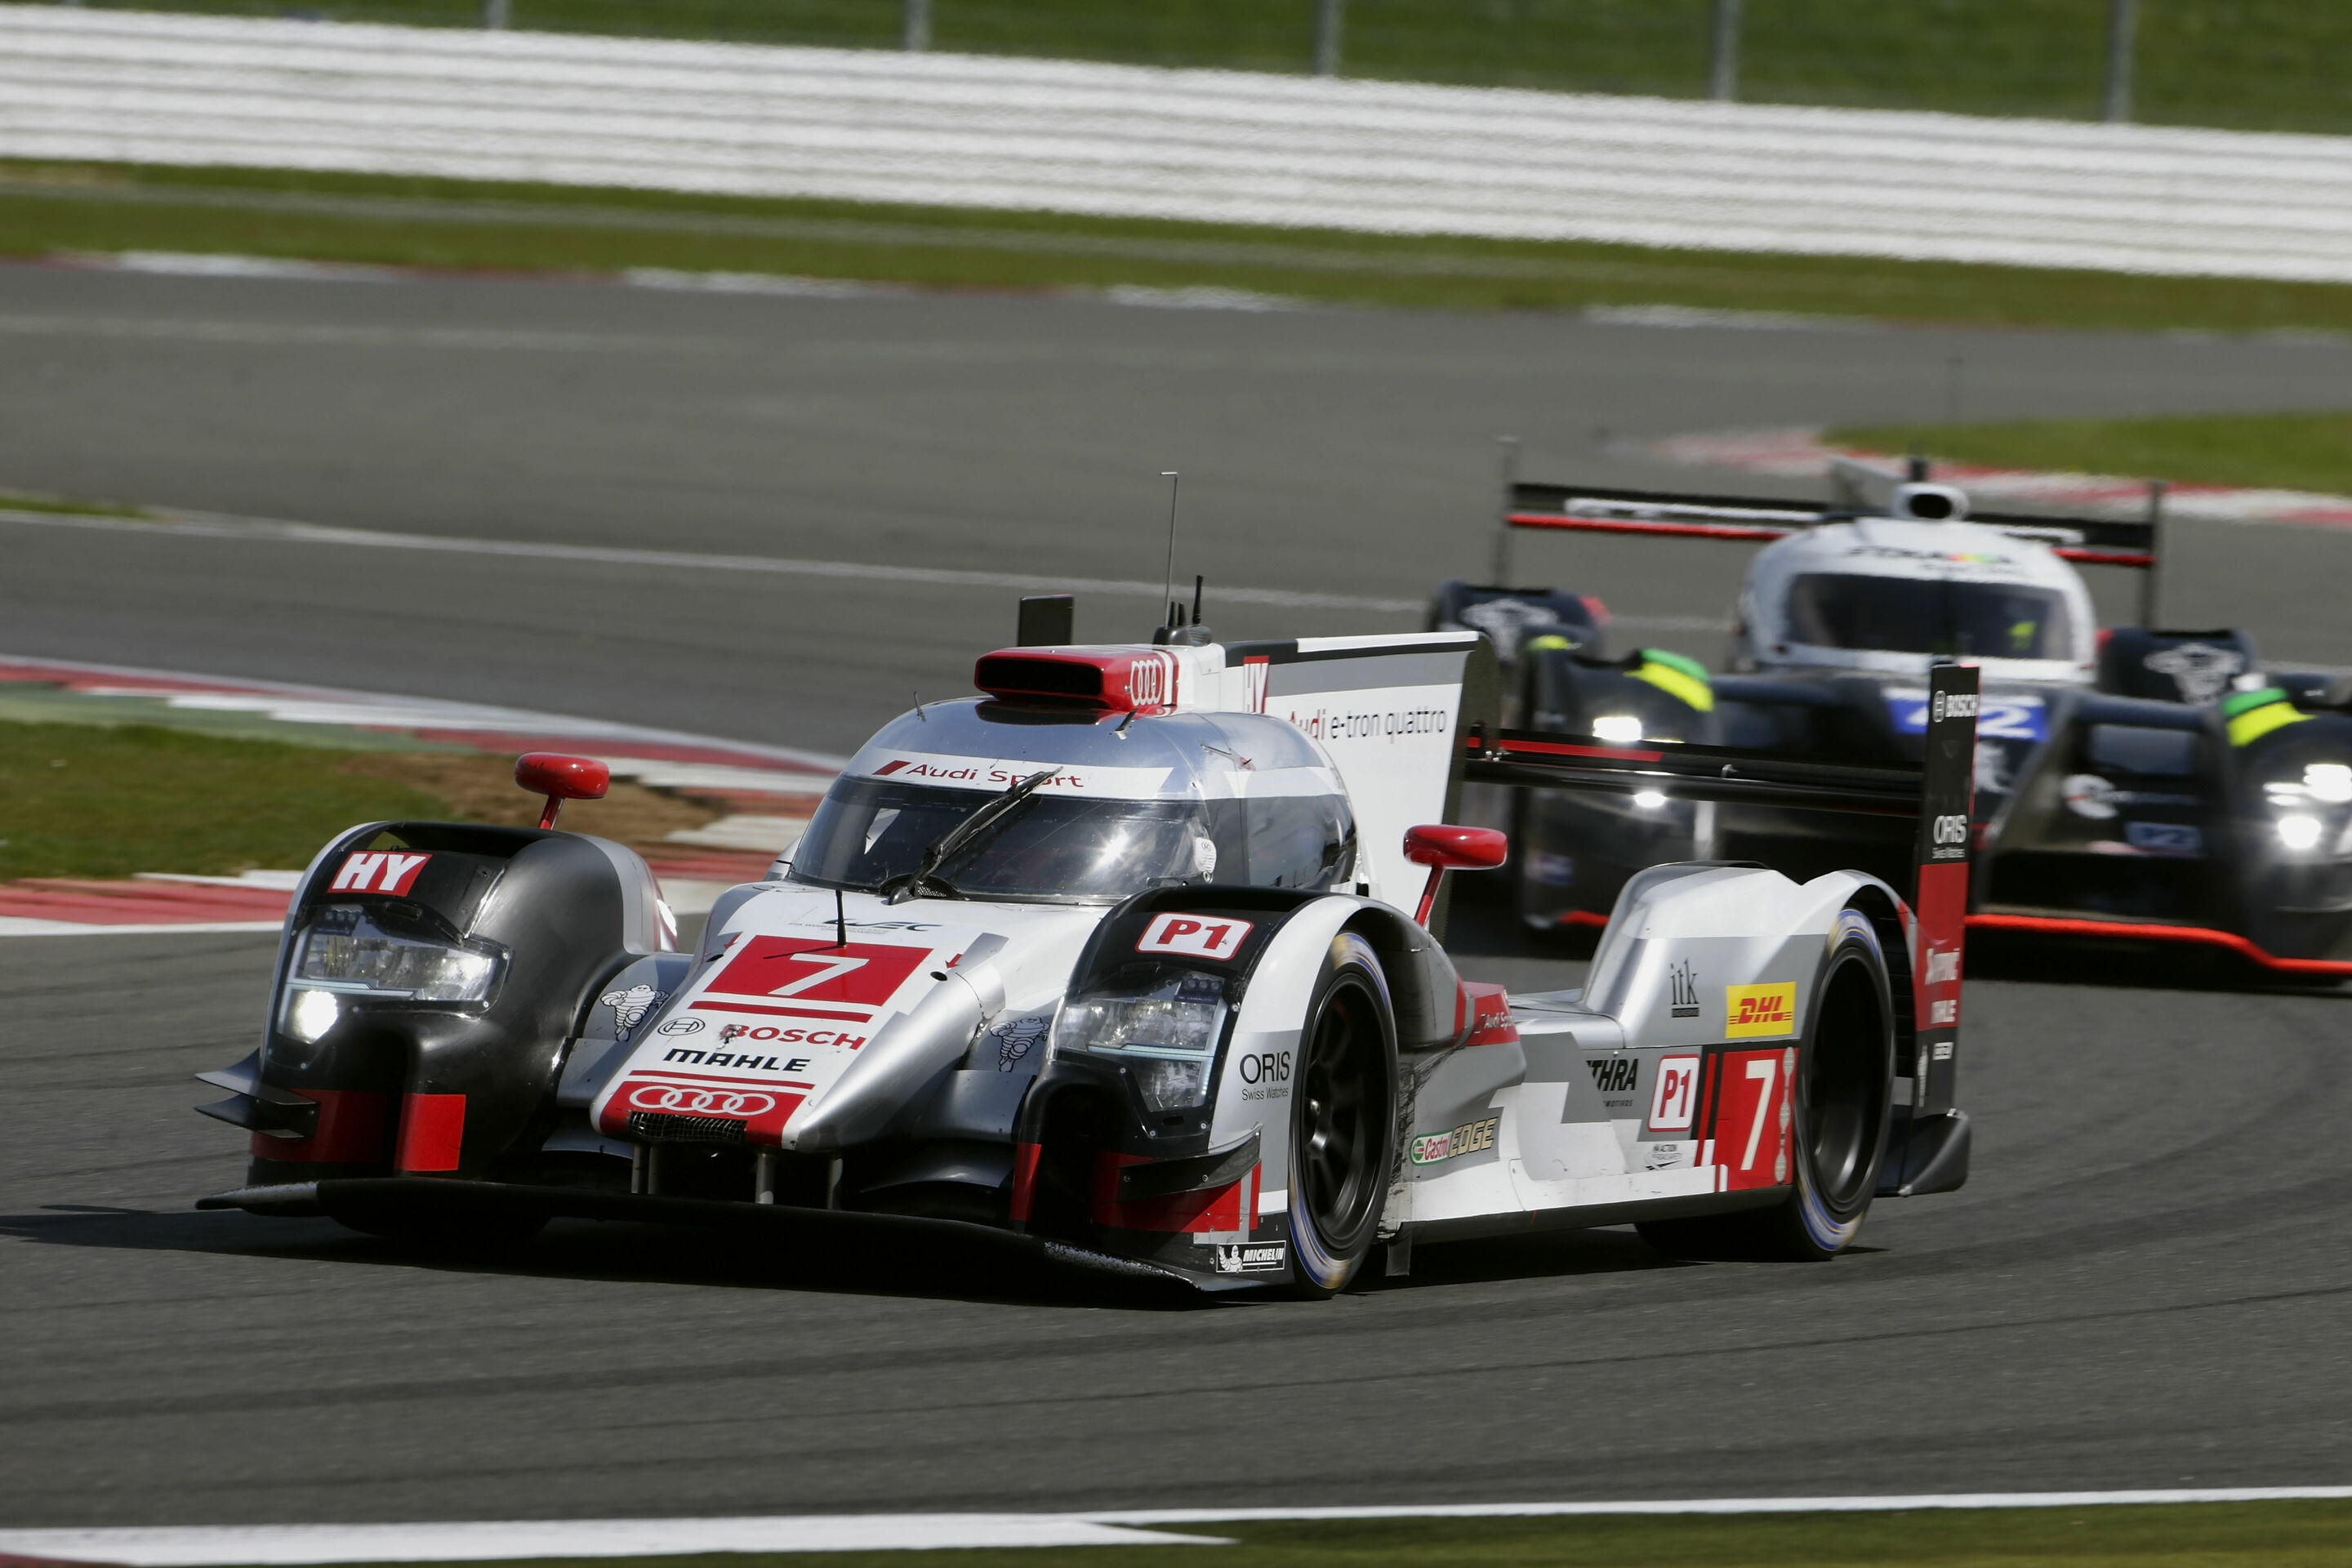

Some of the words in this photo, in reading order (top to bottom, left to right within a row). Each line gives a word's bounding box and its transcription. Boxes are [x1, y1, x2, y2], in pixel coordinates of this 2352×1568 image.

[1242, 662, 1269, 714] HY
[1330, 711, 1380, 739] e-tron
[1385, 706, 1447, 744] quattro
[906, 764, 979, 780] Audi
[332, 853, 426, 891] HY
[1156, 919, 1232, 951] P1
[767, 952, 870, 996] 7
[1670, 956, 1699, 1005] itk
[1737, 996, 1784, 1024] DHL
[662, 1048, 812, 1072] MAHLE
[1239, 1050, 1290, 1085] ORIS
[1585, 1058, 1640, 1092] THRA
[1241, 1088, 1265, 1101] Swiss
[1266, 1086, 1290, 1099] Watches
[1658, 1069, 1692, 1118] P1
[1740, 1059, 1777, 1171] 7
[1448, 1116, 1499, 1160] EDGE
[1242, 1247, 1285, 1263] MICHELIN
